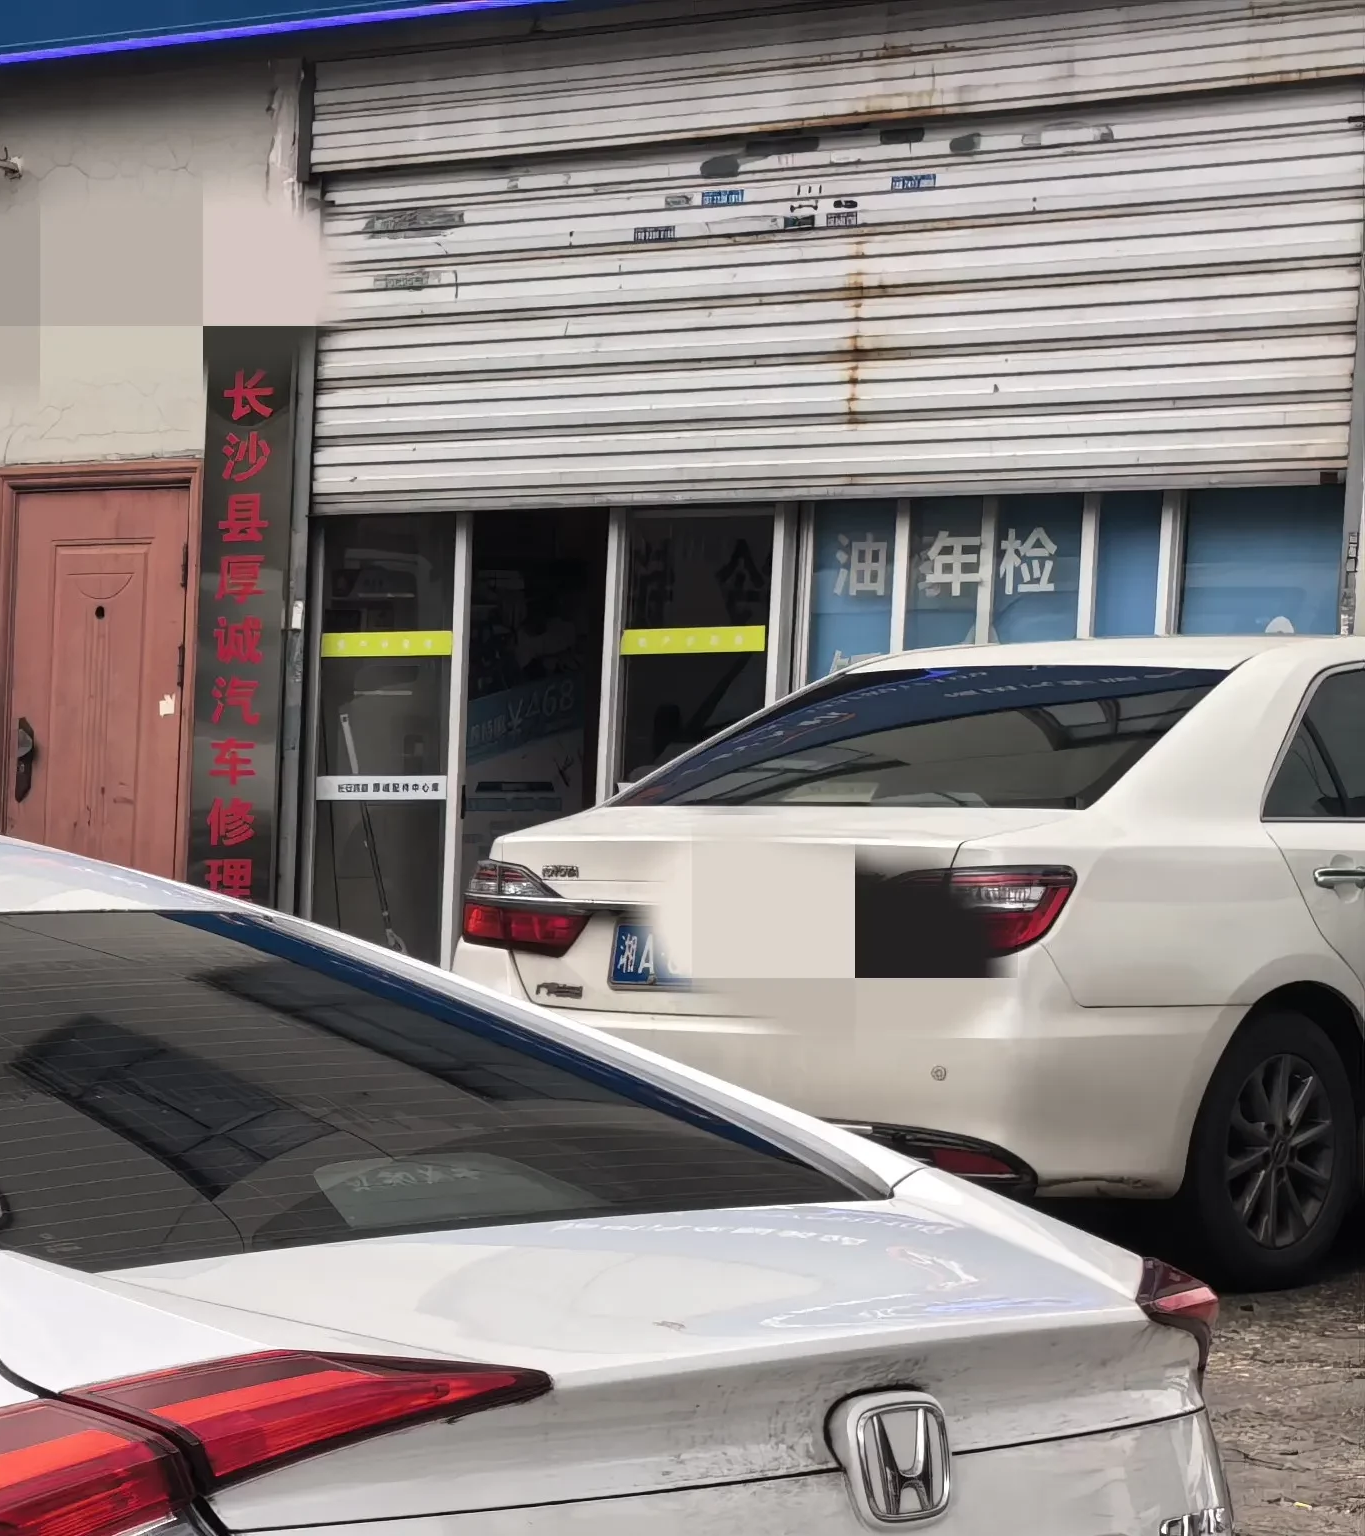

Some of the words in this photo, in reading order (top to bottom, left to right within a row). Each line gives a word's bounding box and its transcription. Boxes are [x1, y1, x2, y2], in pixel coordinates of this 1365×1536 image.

[204, 366, 276, 899] 长沙县厚诚汽车修理
